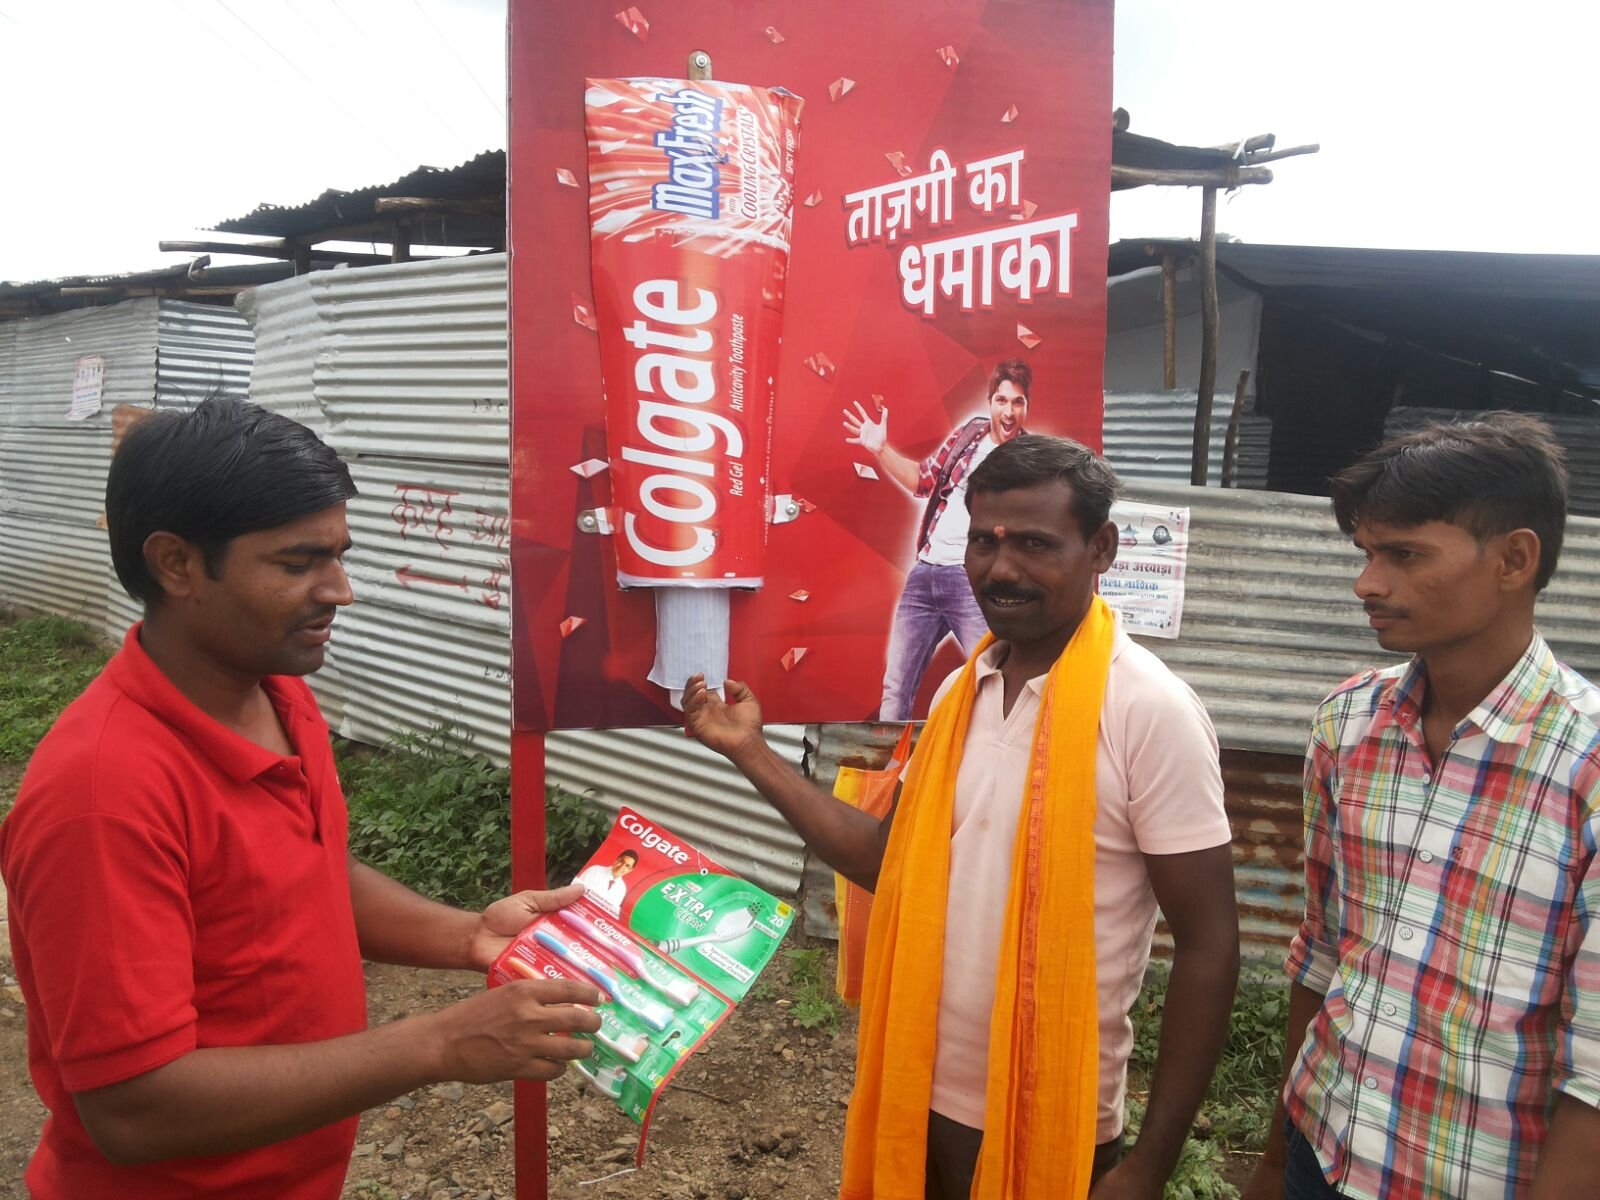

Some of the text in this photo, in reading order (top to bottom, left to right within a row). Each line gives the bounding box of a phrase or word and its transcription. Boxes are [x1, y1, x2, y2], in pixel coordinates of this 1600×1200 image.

[845, 149, 1025, 242] ताज़गी का
[899, 212, 1078, 315] धमाका
[622, 279, 743, 567] Colgate
[729, 314, 747, 496] Red Gel Anticavity Toothpaste
[620, 814, 688, 864] Colgate
[593, 917, 632, 947] Colgate
[661, 882, 714, 922] EXTRA
[569, 941, 606, 970] Colgate
